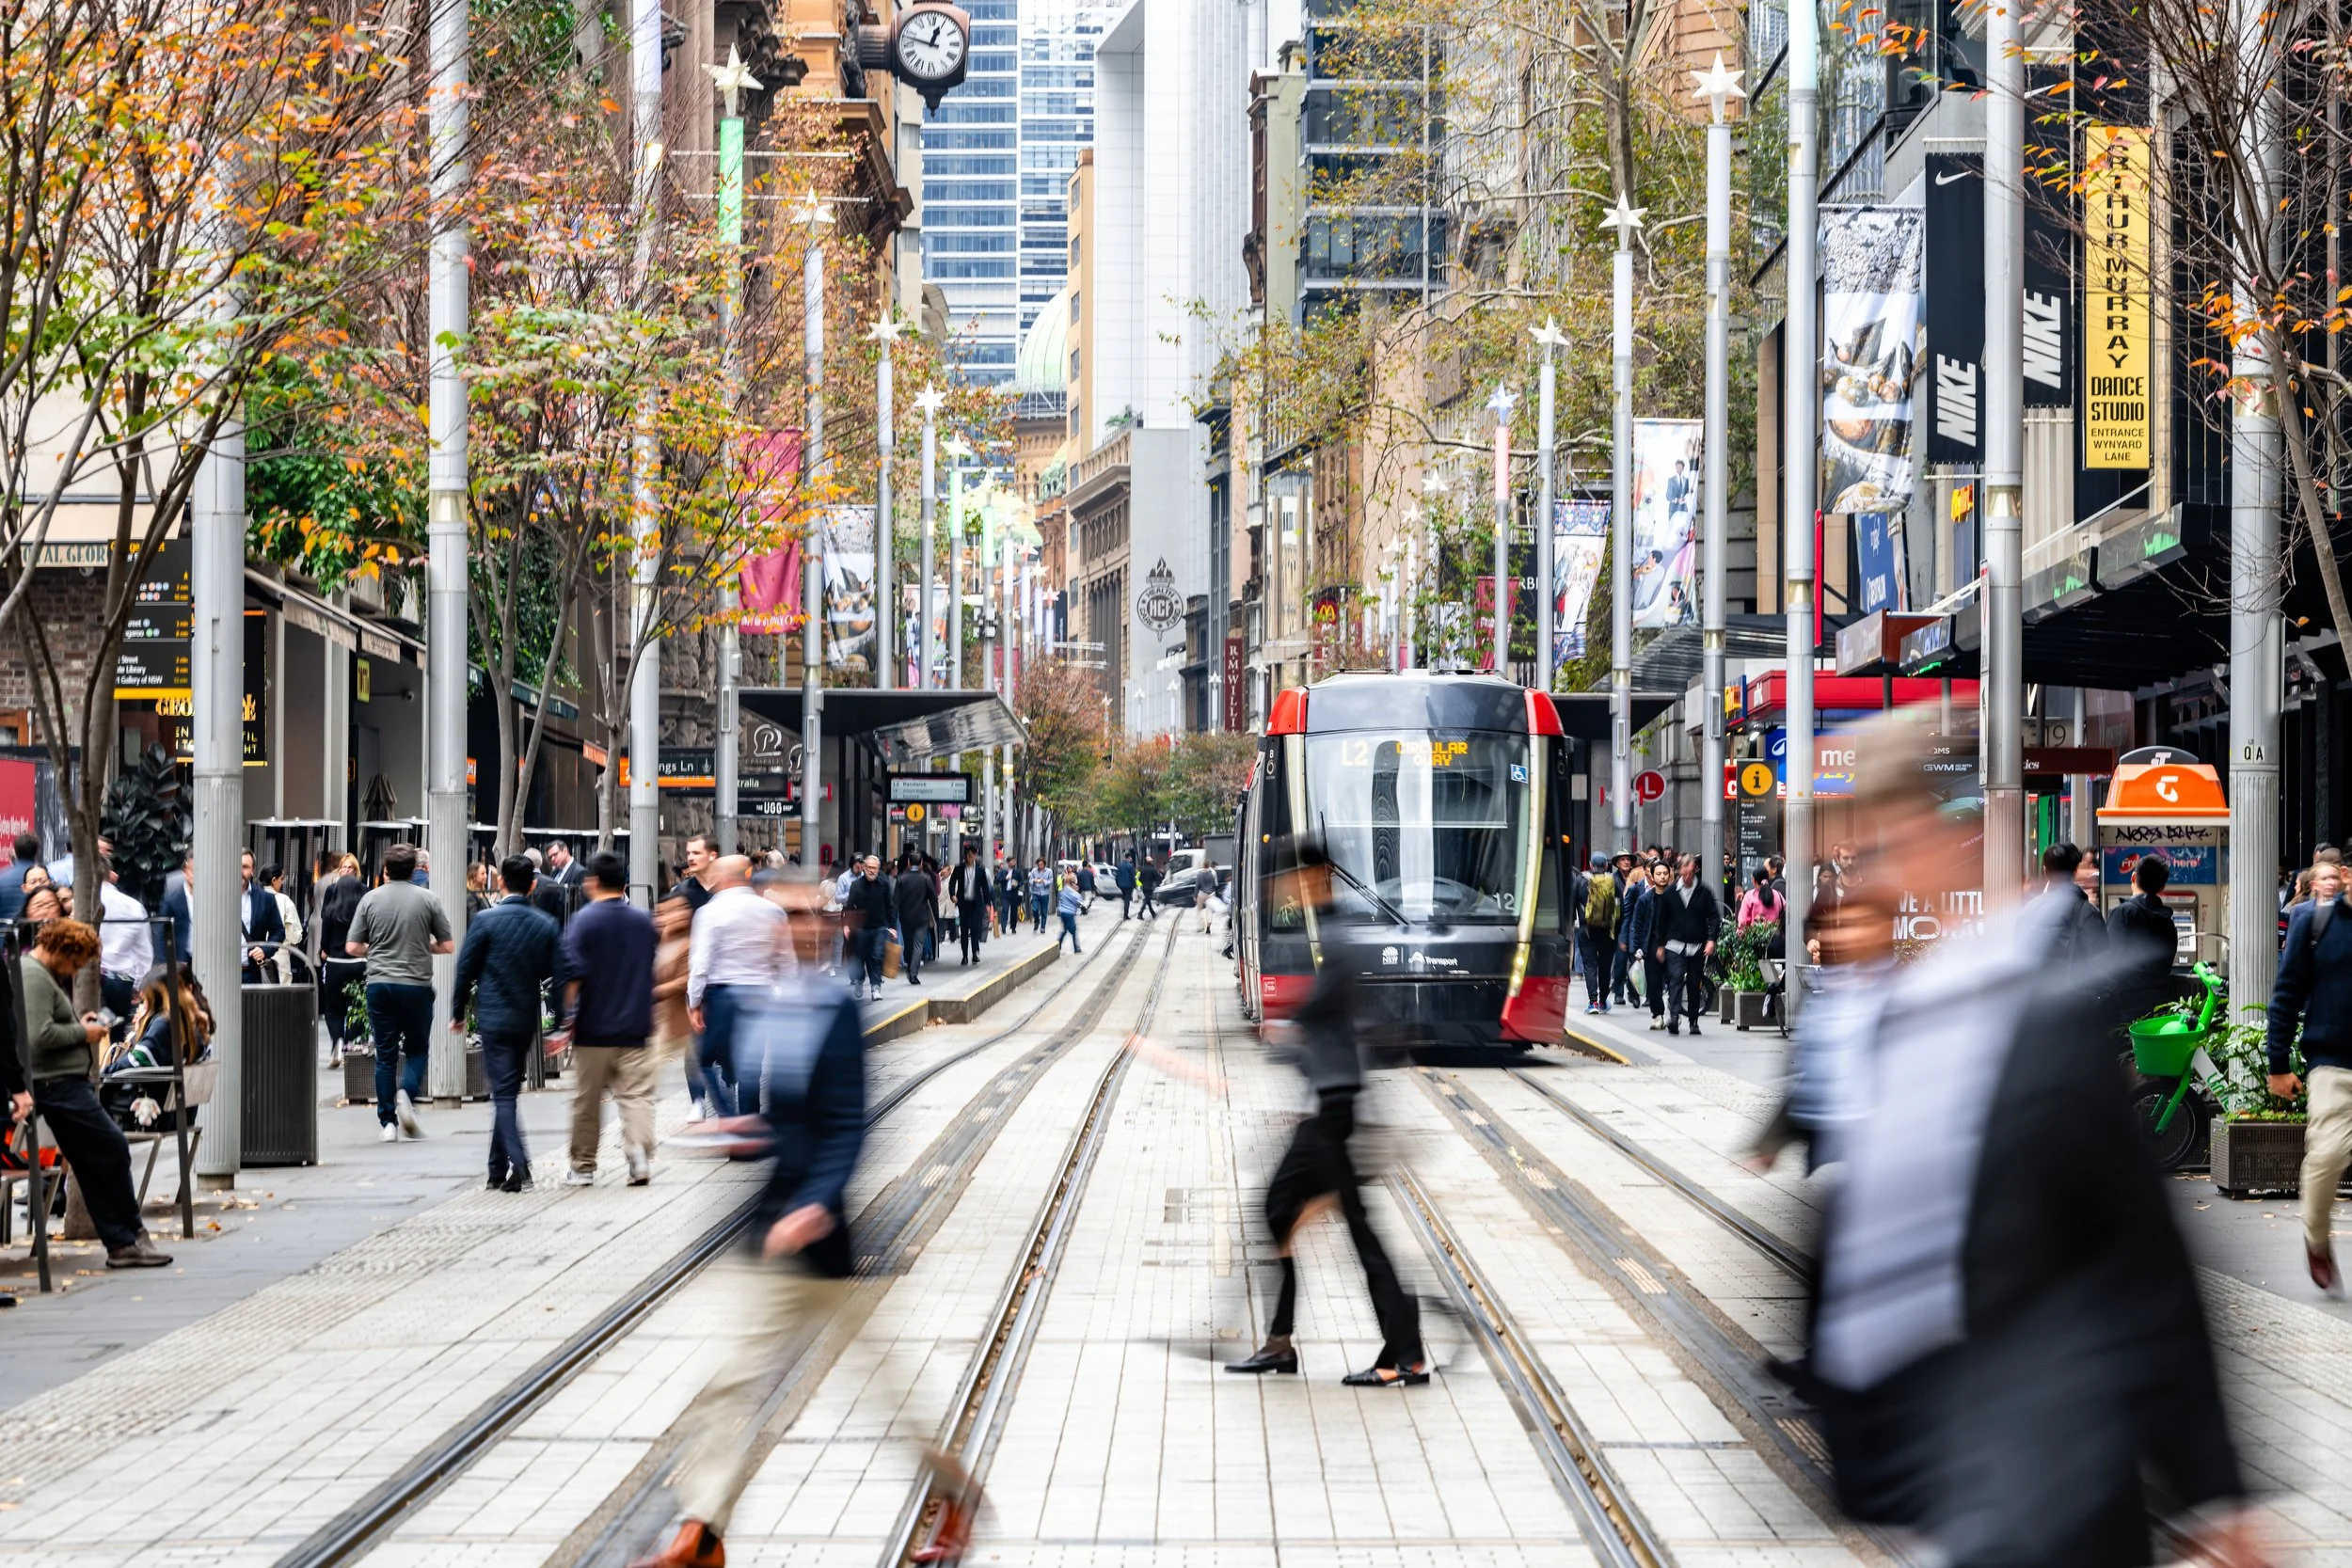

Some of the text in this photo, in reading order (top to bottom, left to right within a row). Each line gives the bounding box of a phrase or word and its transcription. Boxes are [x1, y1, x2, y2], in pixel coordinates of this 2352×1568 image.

[2106, 258, 2129, 369] MURRAY
[2024, 288, 2061, 389] NIKE
[2090, 376, 2145, 397] DANCE
[1937, 353, 1977, 448] NIKE
[2090, 402, 2145, 421] STUDIO
[2090, 428, 2145, 437] ENTRANCE
[2093, 440, 2142, 450] WYNYARD
[2105, 452, 2131, 461] LANE
[66, 545, 107, 563] GEOR
[1149, 599, 1171, 617] HCF
[126, 666, 147, 674] Library
[1342, 740, 1468, 767] L2 CIRCULAR
[659, 760, 694, 774] ngs Ln
[1645, 776, 1656, 795] L
[764, 801, 782, 815] UGG
[1493, 893, 1517, 911] 12
